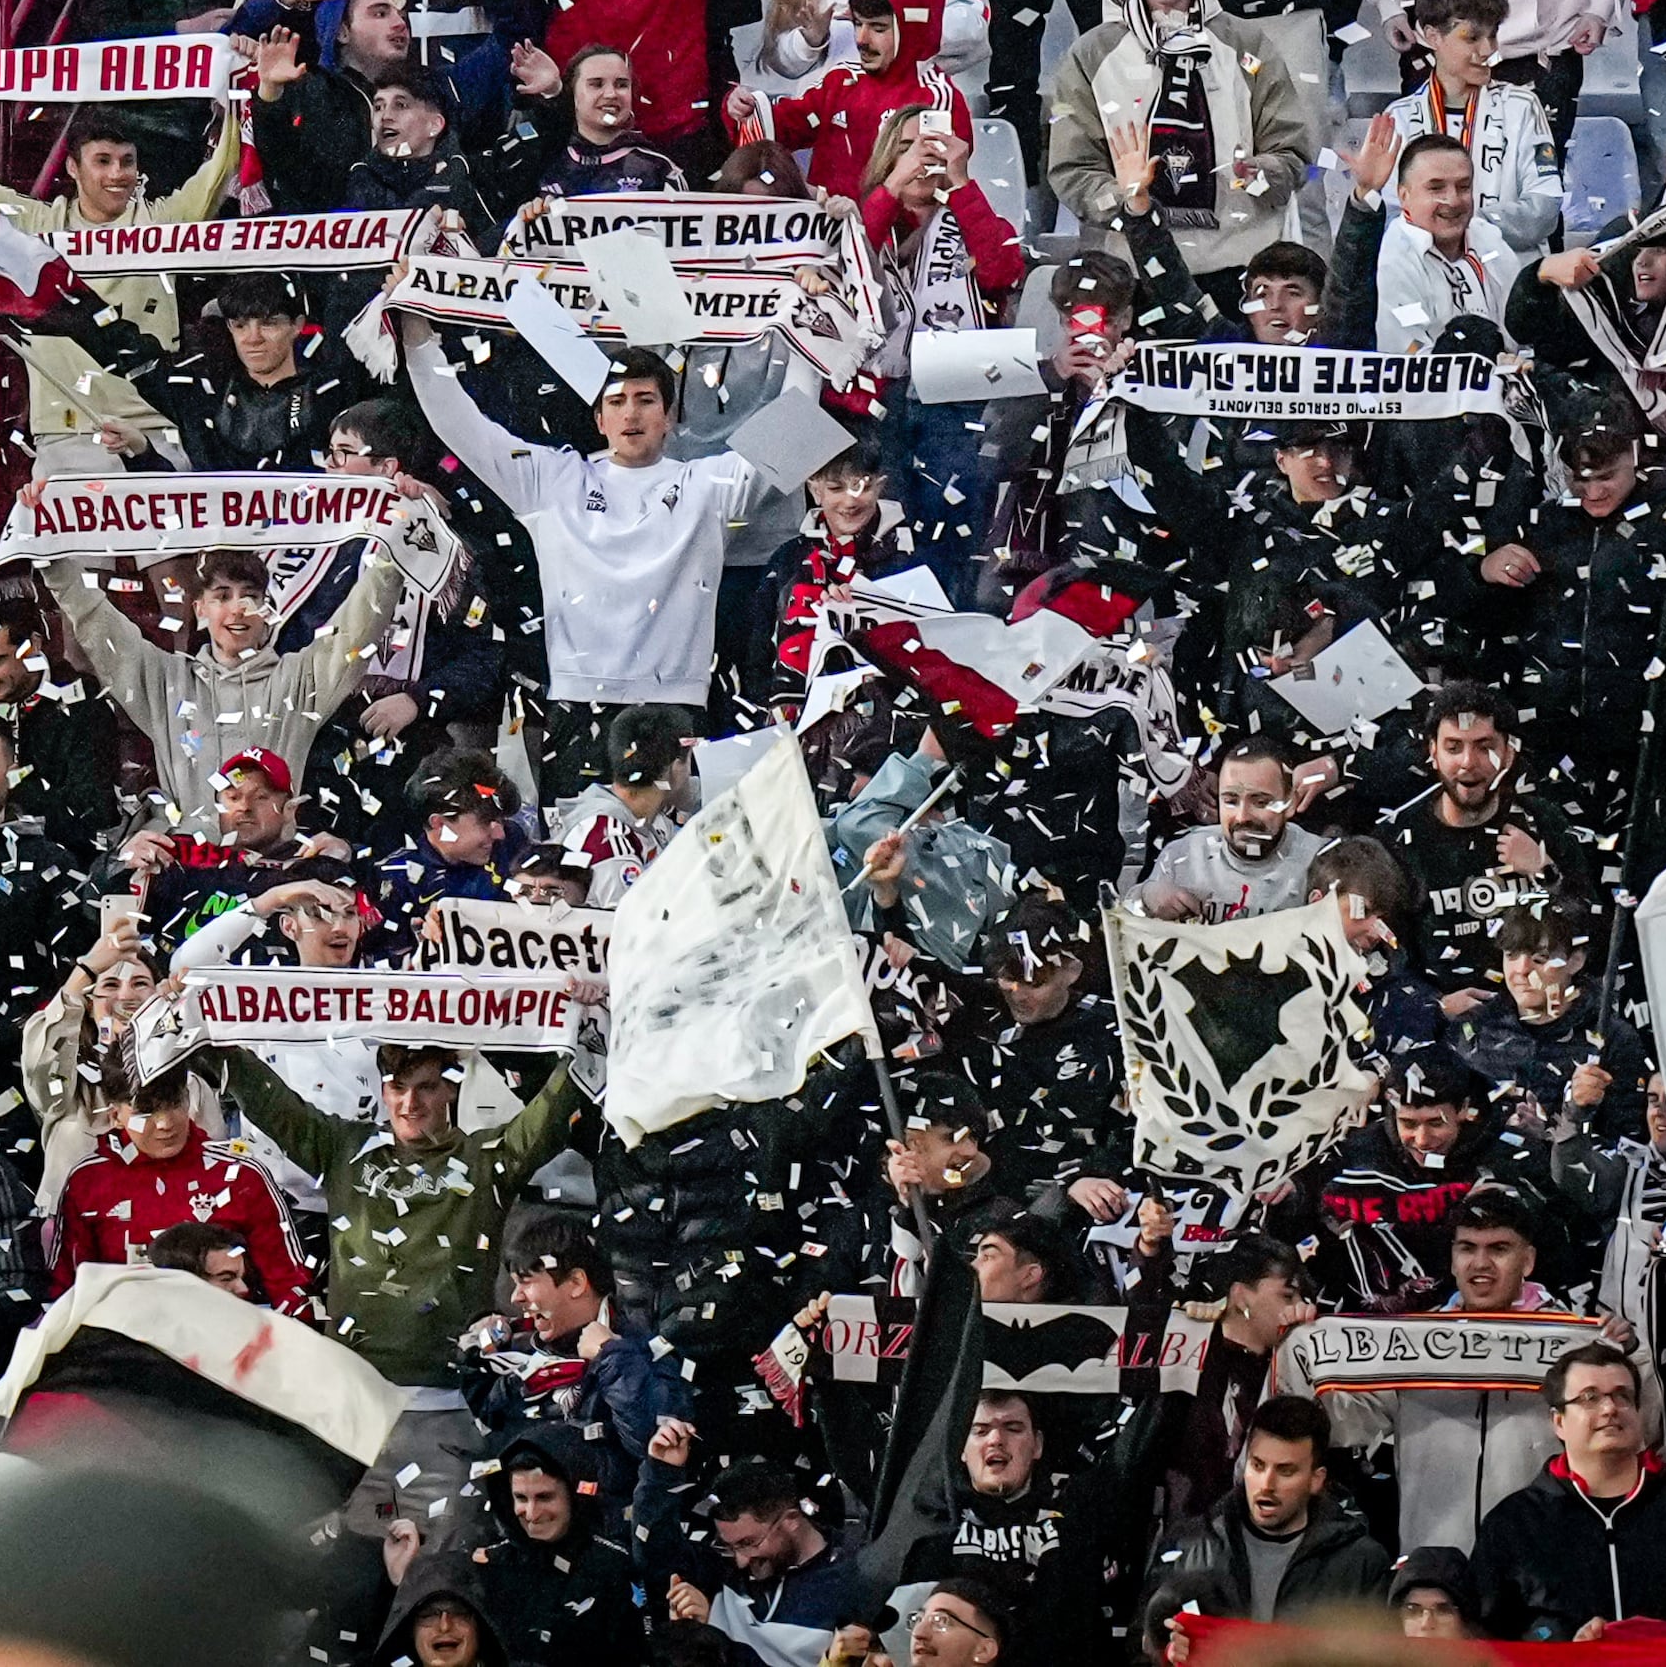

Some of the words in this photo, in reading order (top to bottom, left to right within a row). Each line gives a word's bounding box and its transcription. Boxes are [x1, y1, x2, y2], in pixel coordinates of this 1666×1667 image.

[100, 43, 214, 92] ALBA
[525, 214, 704, 251] ALBATE
[409, 266, 591, 312] ALBACTE
[1313, 354, 1494, 393] ALBACETE
[1208, 398, 1283, 414] BELMONTE
[1289, 401, 1341, 415] CARLOS
[33, 492, 208, 537] ALBACETE
[198, 985, 374, 1023] ALBACETE
[784, 1344, 807, 1366] 19
[1099, 1331, 1210, 1371] ALBA
[1291, 1324, 1566, 1385] ALBACETE
[951, 1518, 1059, 1552] ALBACTE
